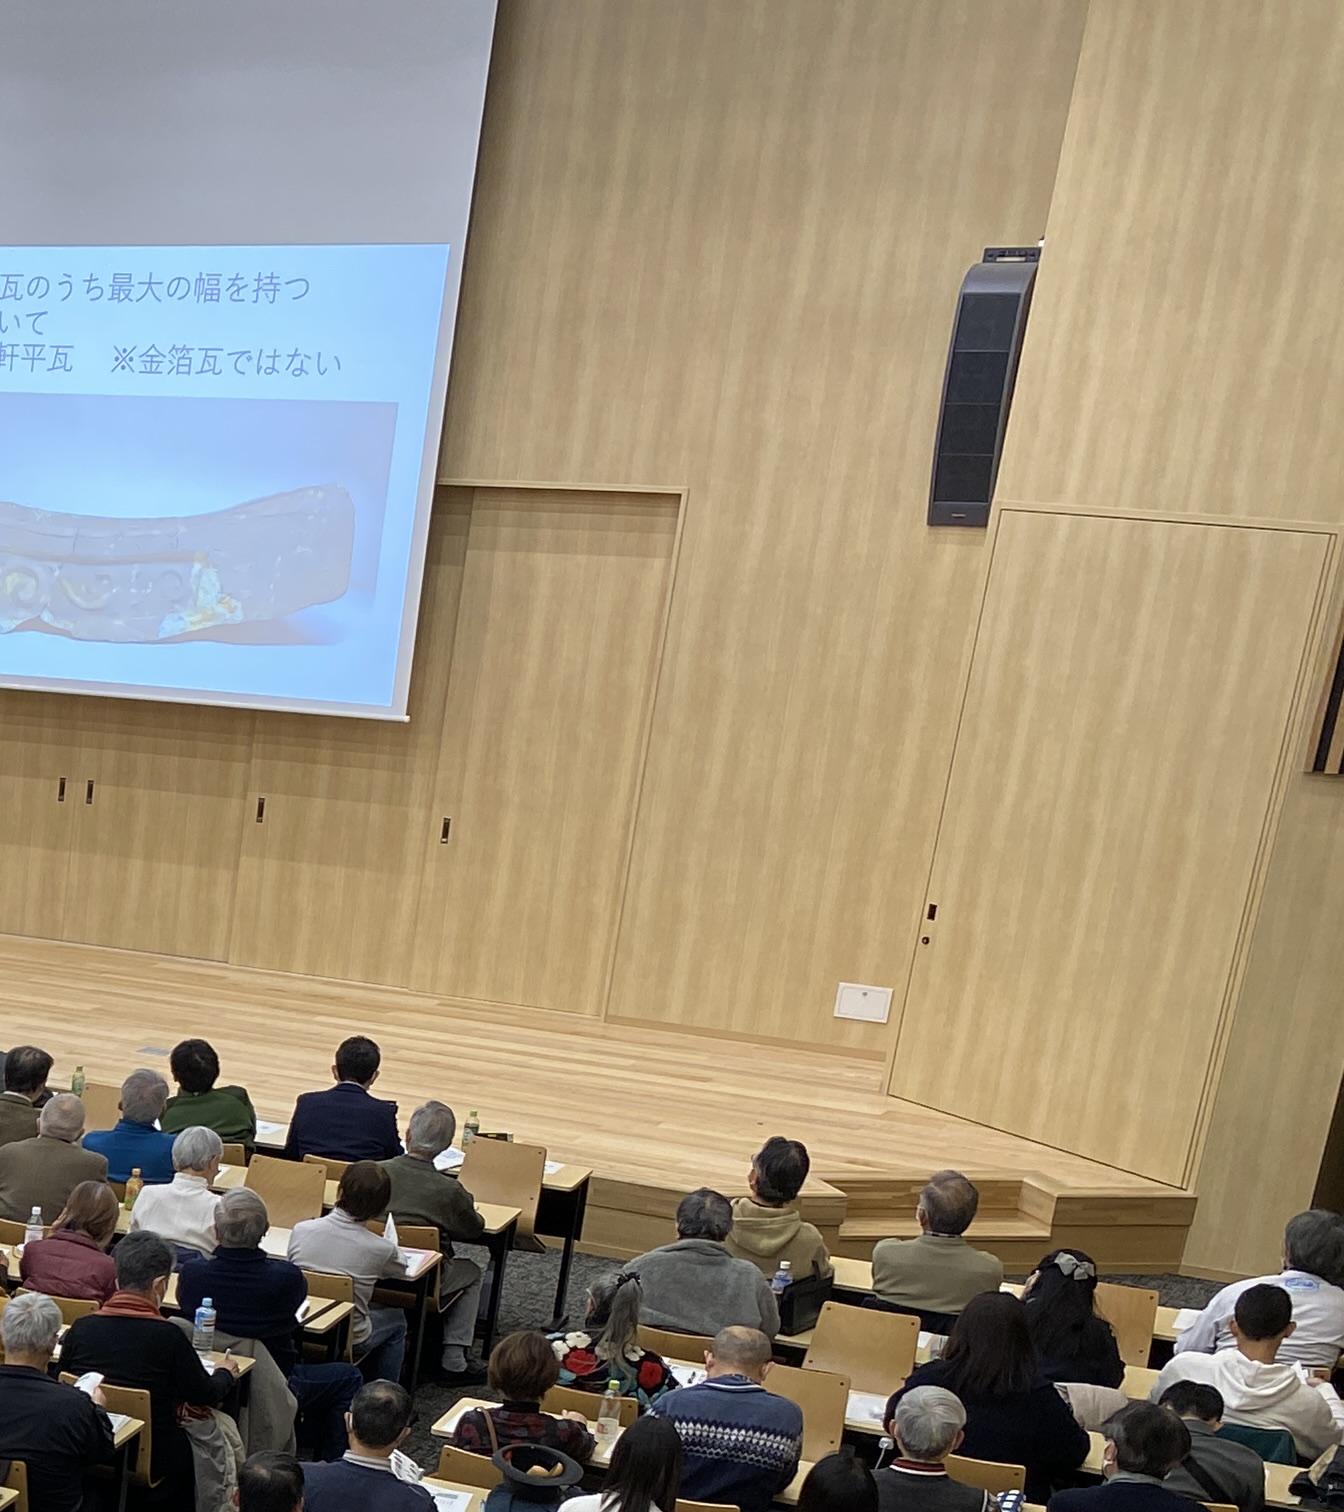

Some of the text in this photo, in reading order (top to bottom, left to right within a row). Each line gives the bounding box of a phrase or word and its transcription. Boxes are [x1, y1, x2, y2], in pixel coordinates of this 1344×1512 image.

[111, 343, 342, 377] ※金箔瓦ではない
